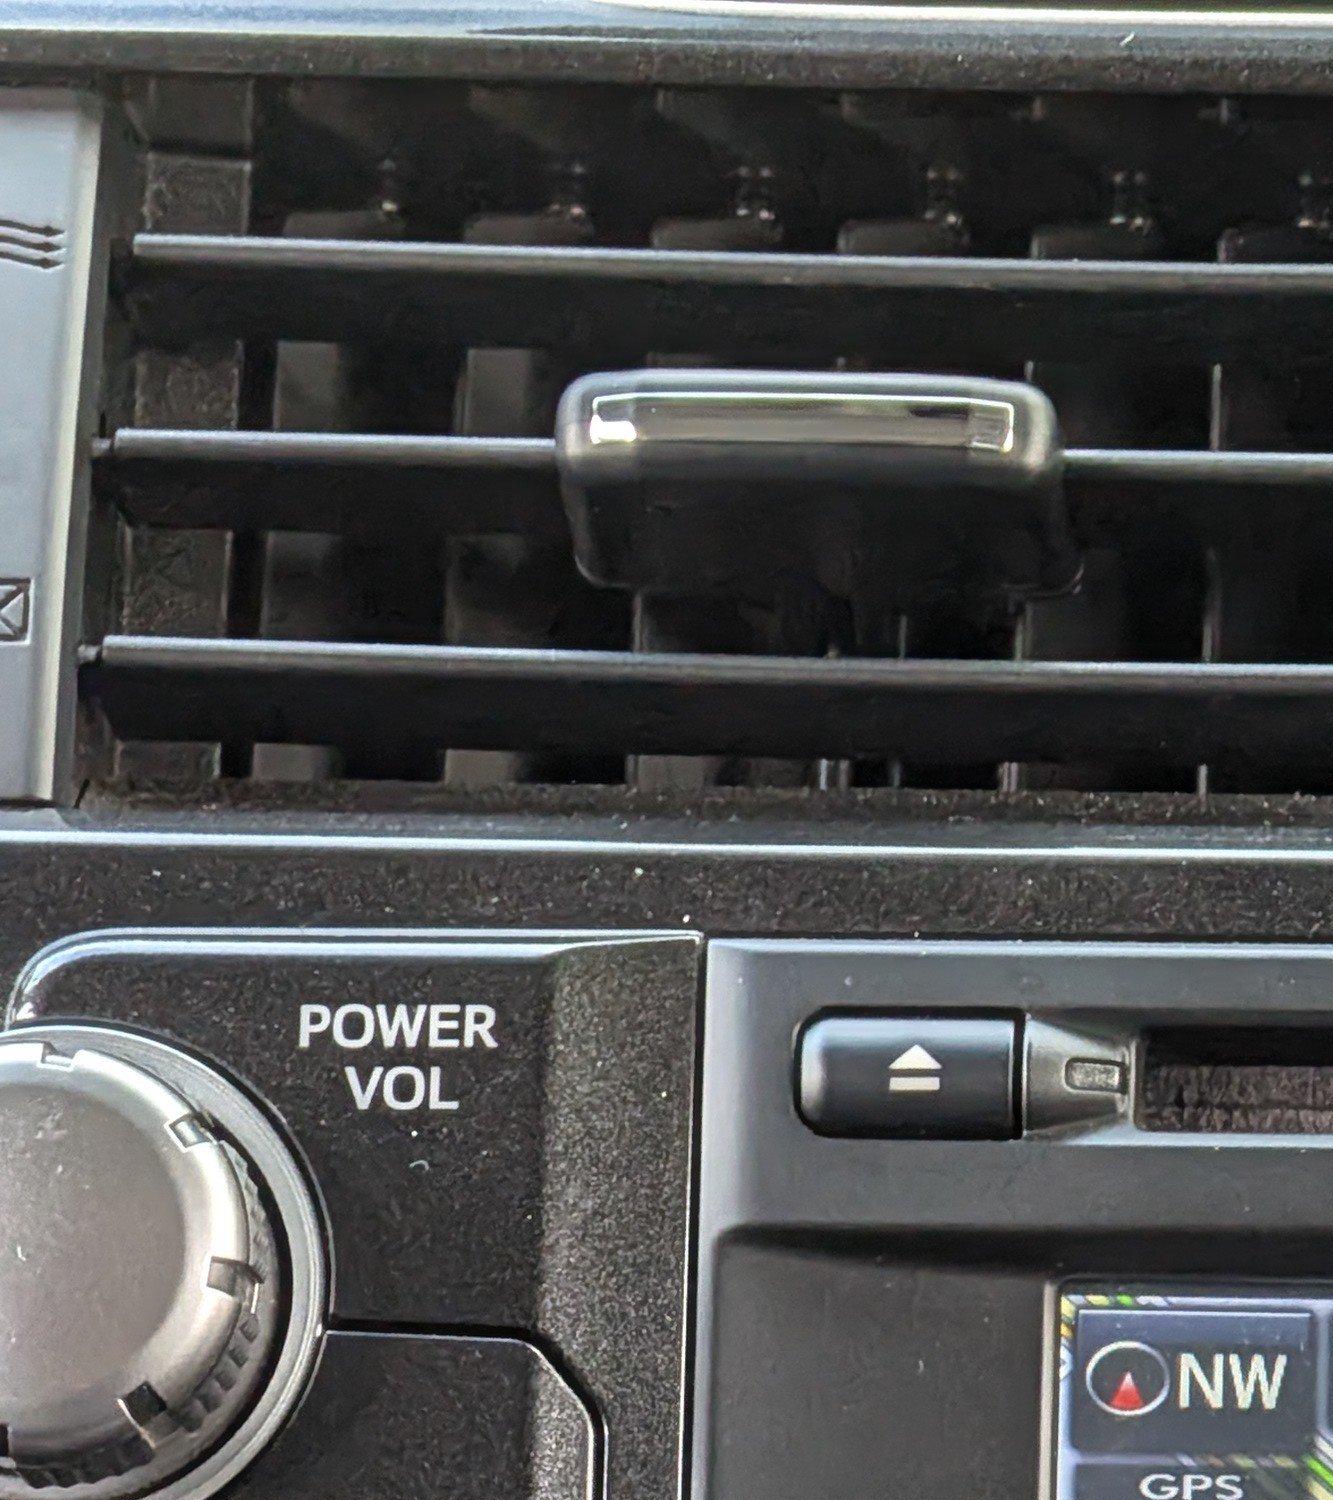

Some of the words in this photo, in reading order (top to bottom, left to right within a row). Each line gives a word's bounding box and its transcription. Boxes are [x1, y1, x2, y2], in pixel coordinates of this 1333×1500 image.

[298, 1003, 500, 1050] POWER
[344, 1066, 460, 1111] VOL
[1177, 1353, 1288, 1411] NW
